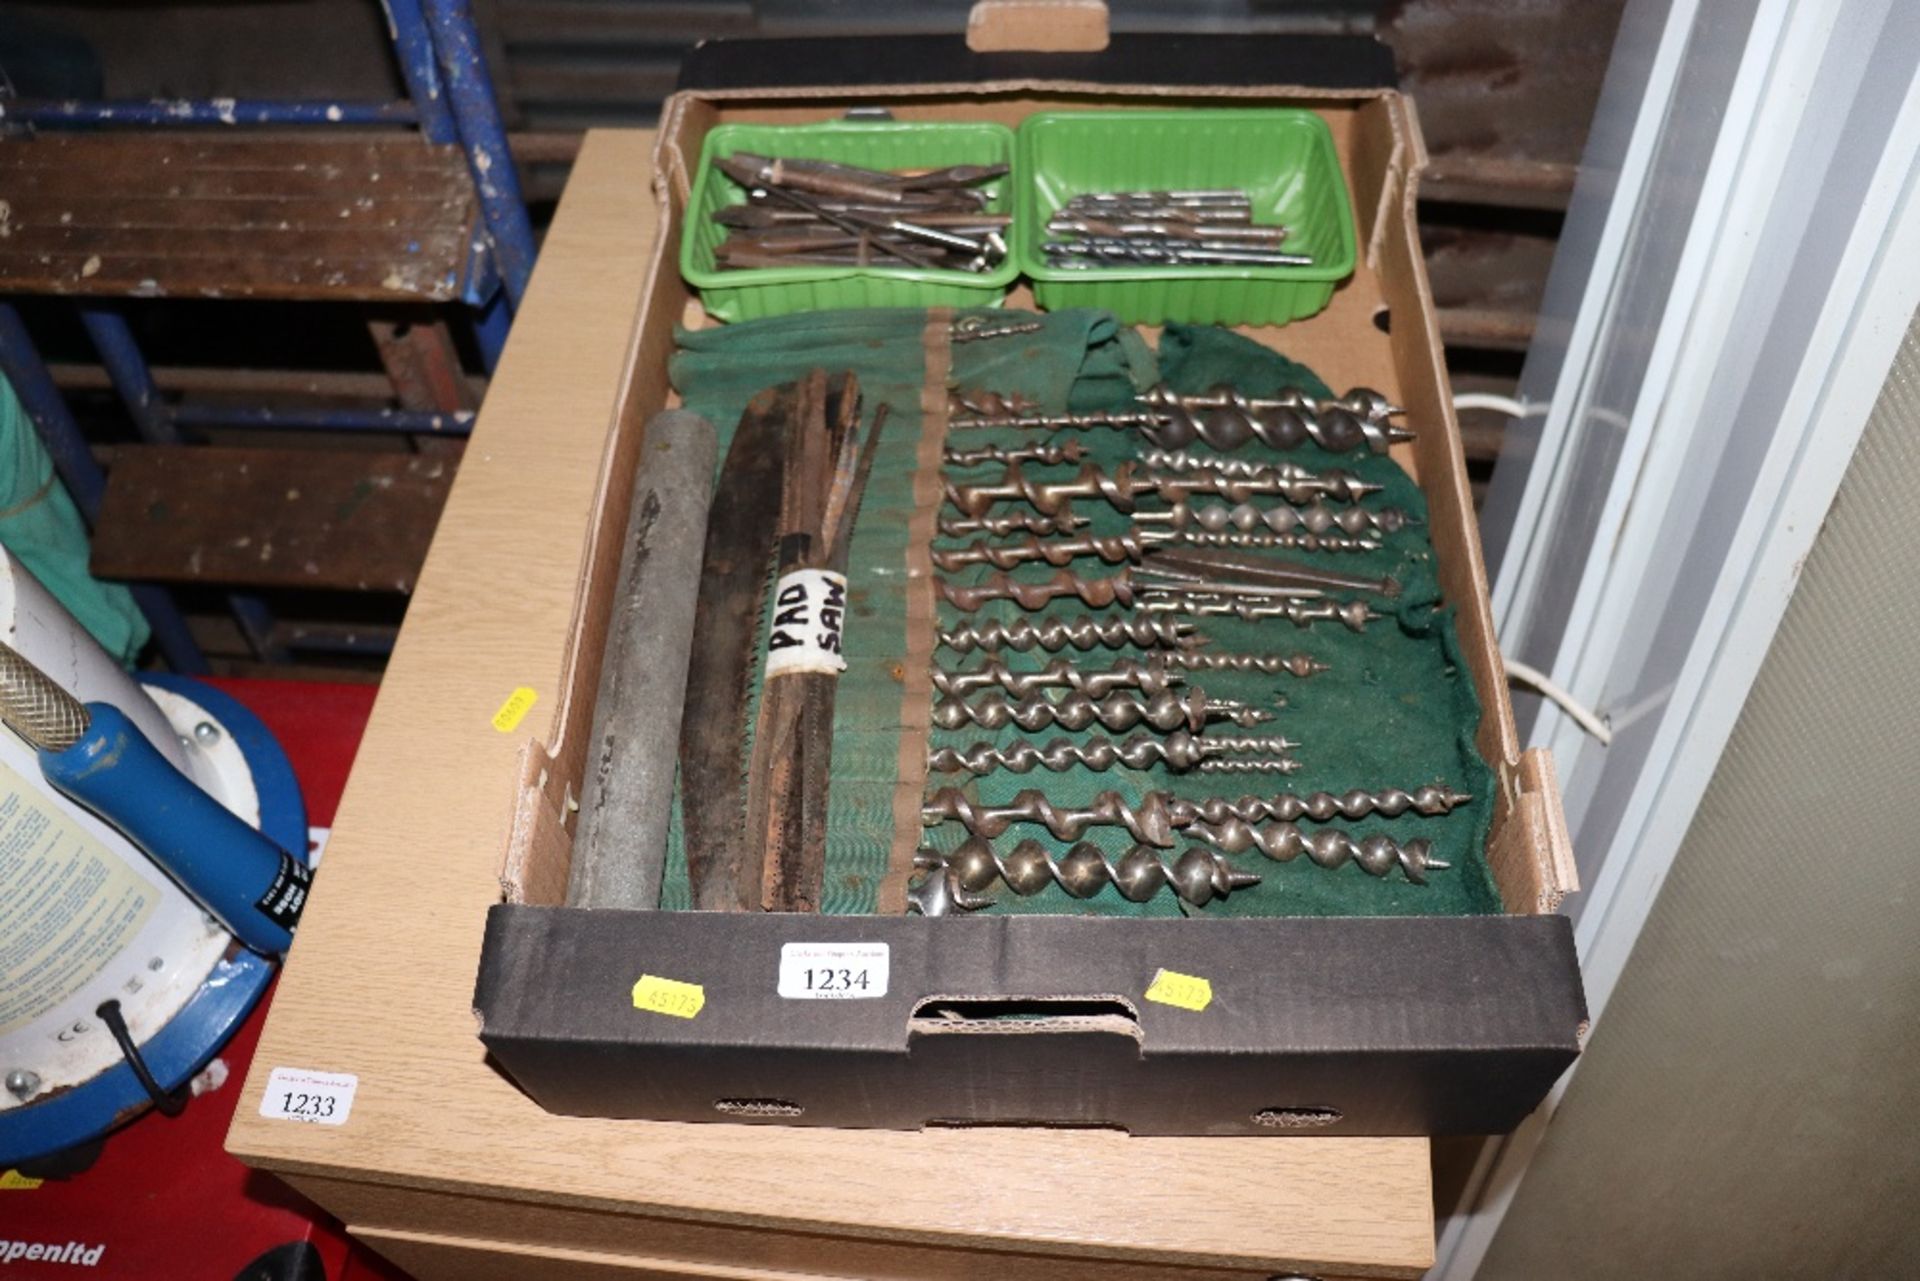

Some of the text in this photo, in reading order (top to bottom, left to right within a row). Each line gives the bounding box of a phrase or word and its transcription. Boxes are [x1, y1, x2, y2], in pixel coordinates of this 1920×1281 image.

[769, 583, 809, 652] PAD
[816, 575, 845, 655] SAW
[803, 968, 871, 991] 1234
[282, 1091, 336, 1117] 1233
